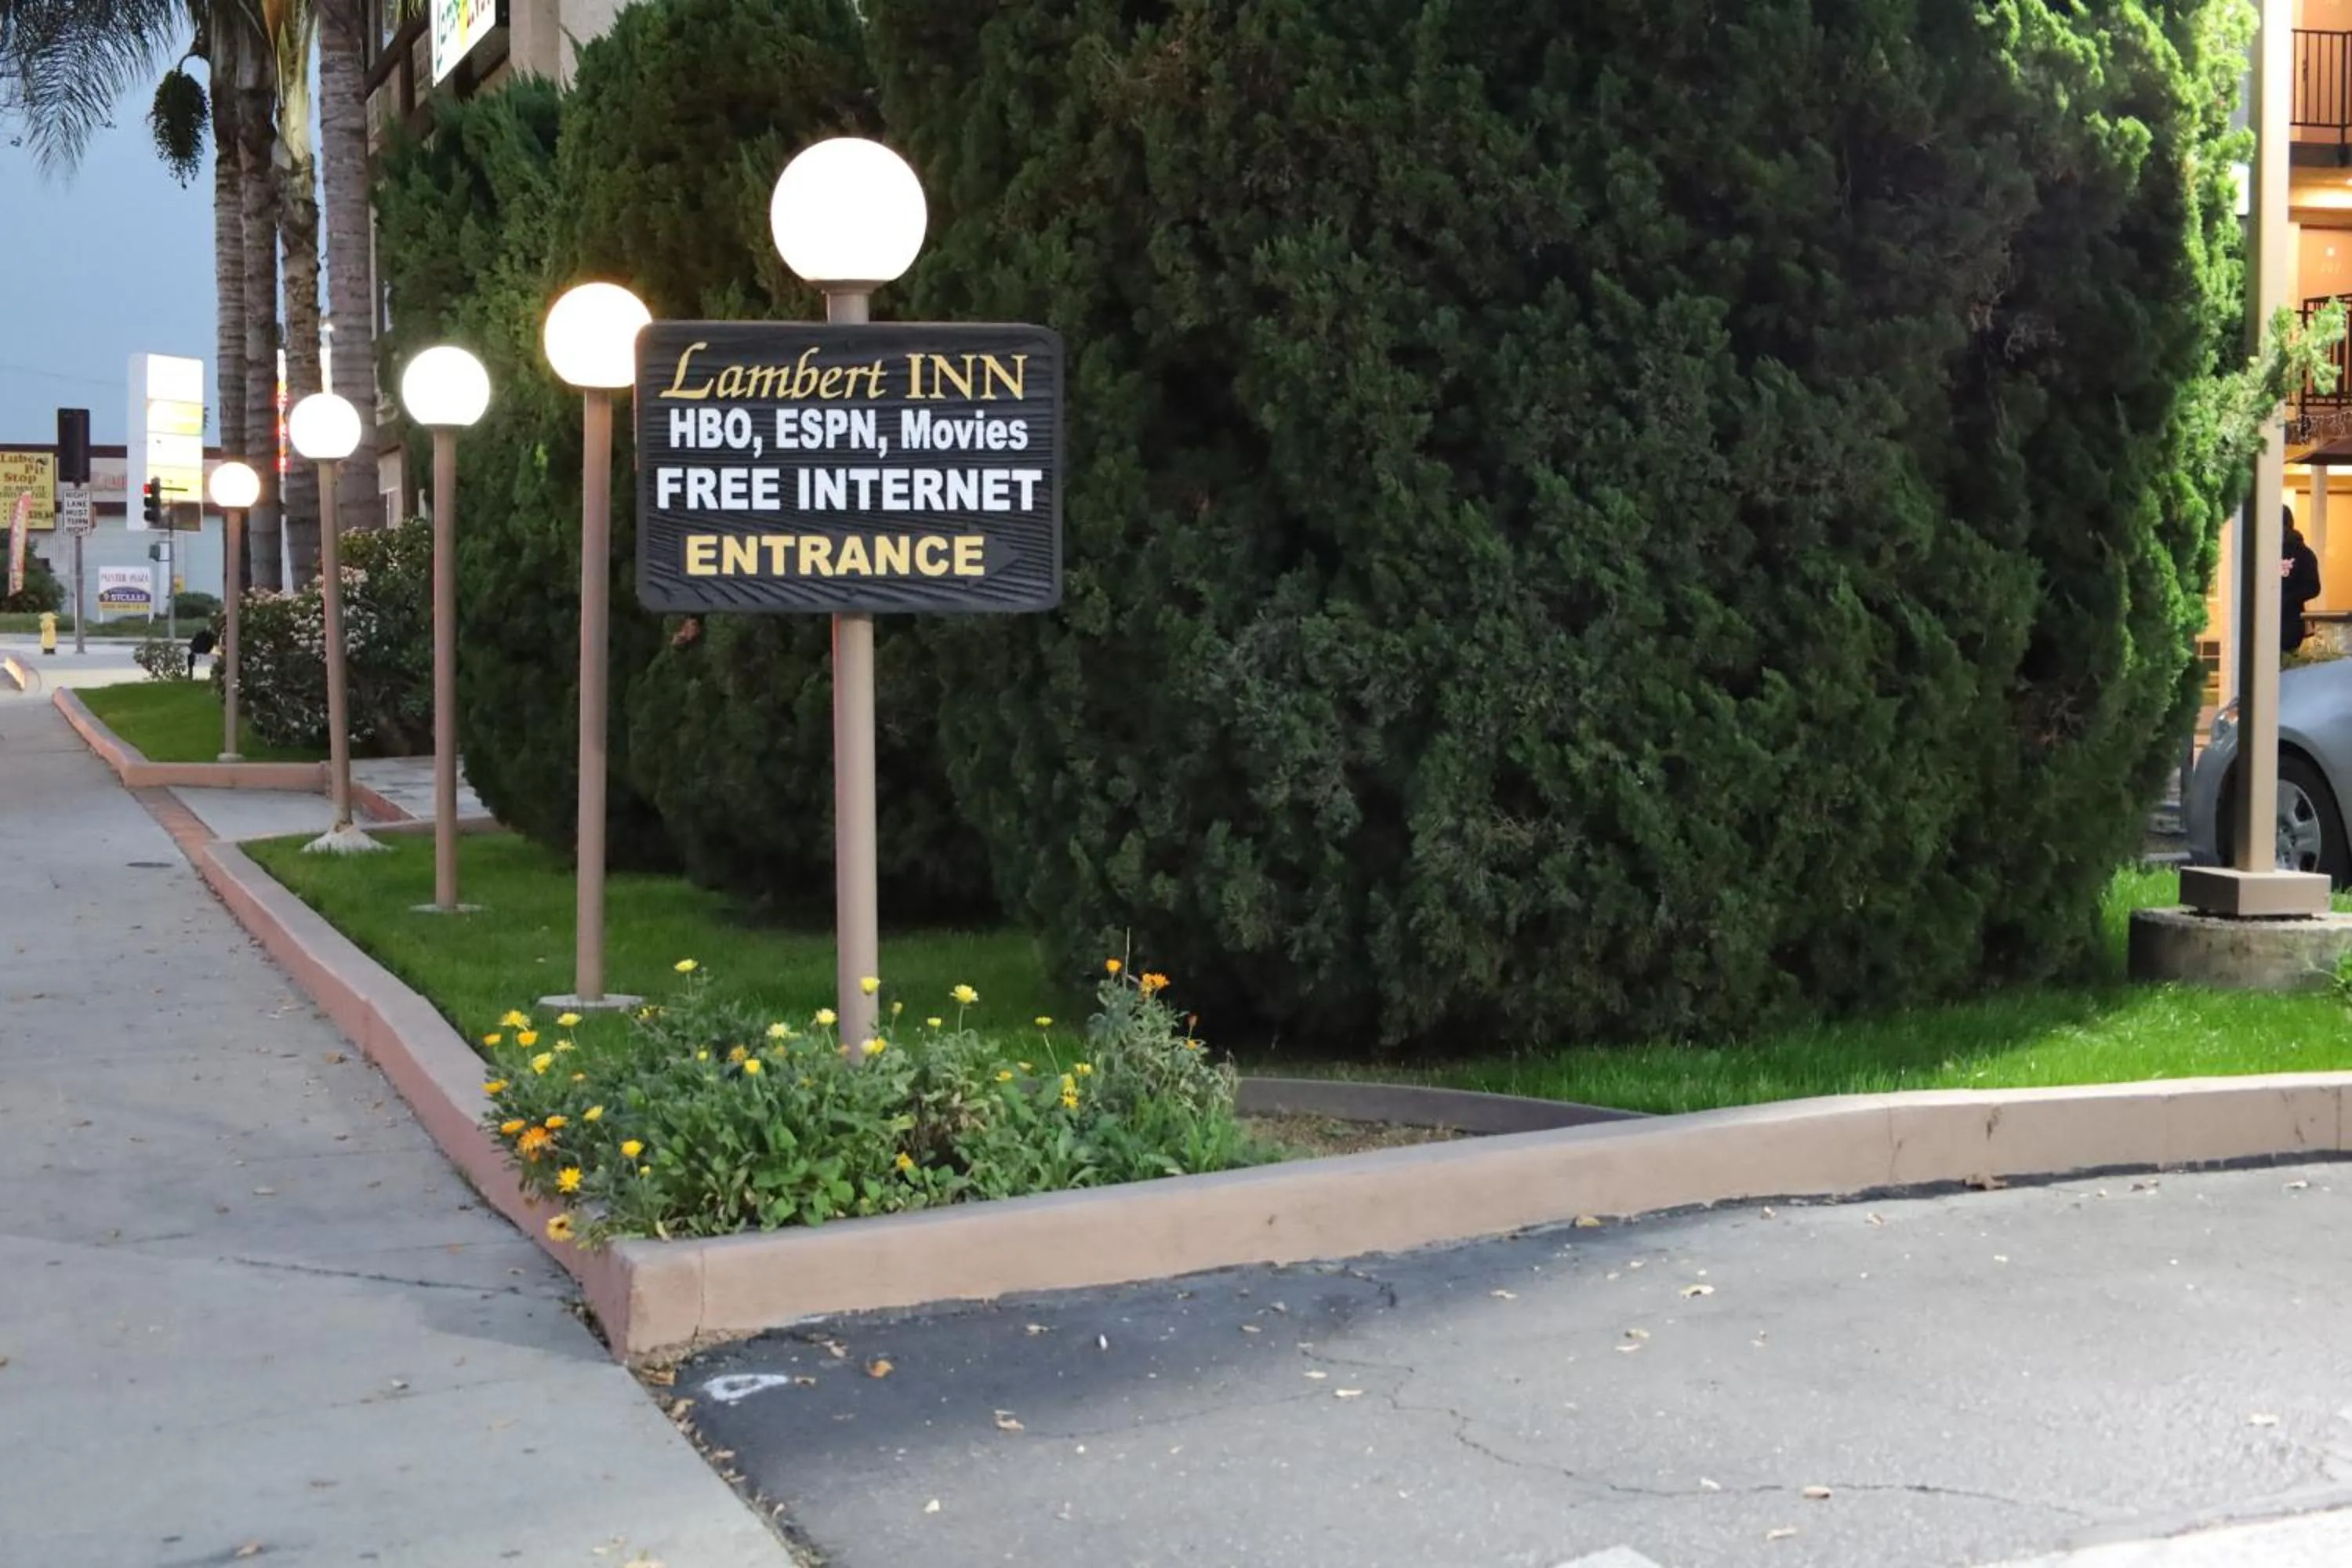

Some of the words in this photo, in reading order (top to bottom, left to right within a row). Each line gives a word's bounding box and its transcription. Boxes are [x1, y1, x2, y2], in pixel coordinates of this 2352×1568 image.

[660, 342, 889, 400] Lambert
[905, 353, 1029, 401] INN
[669, 408, 764, 457] HBO,
[775, 408, 888, 458] ESPN,
[901, 409, 1029, 451] Movies
[0, 454, 34, 463] Lube
[4, 473, 37, 485] Stop
[657, 468, 781, 511] FREE
[797, 468, 1043, 512] INTERNET
[686, 535, 985, 577] ENTRANCE
